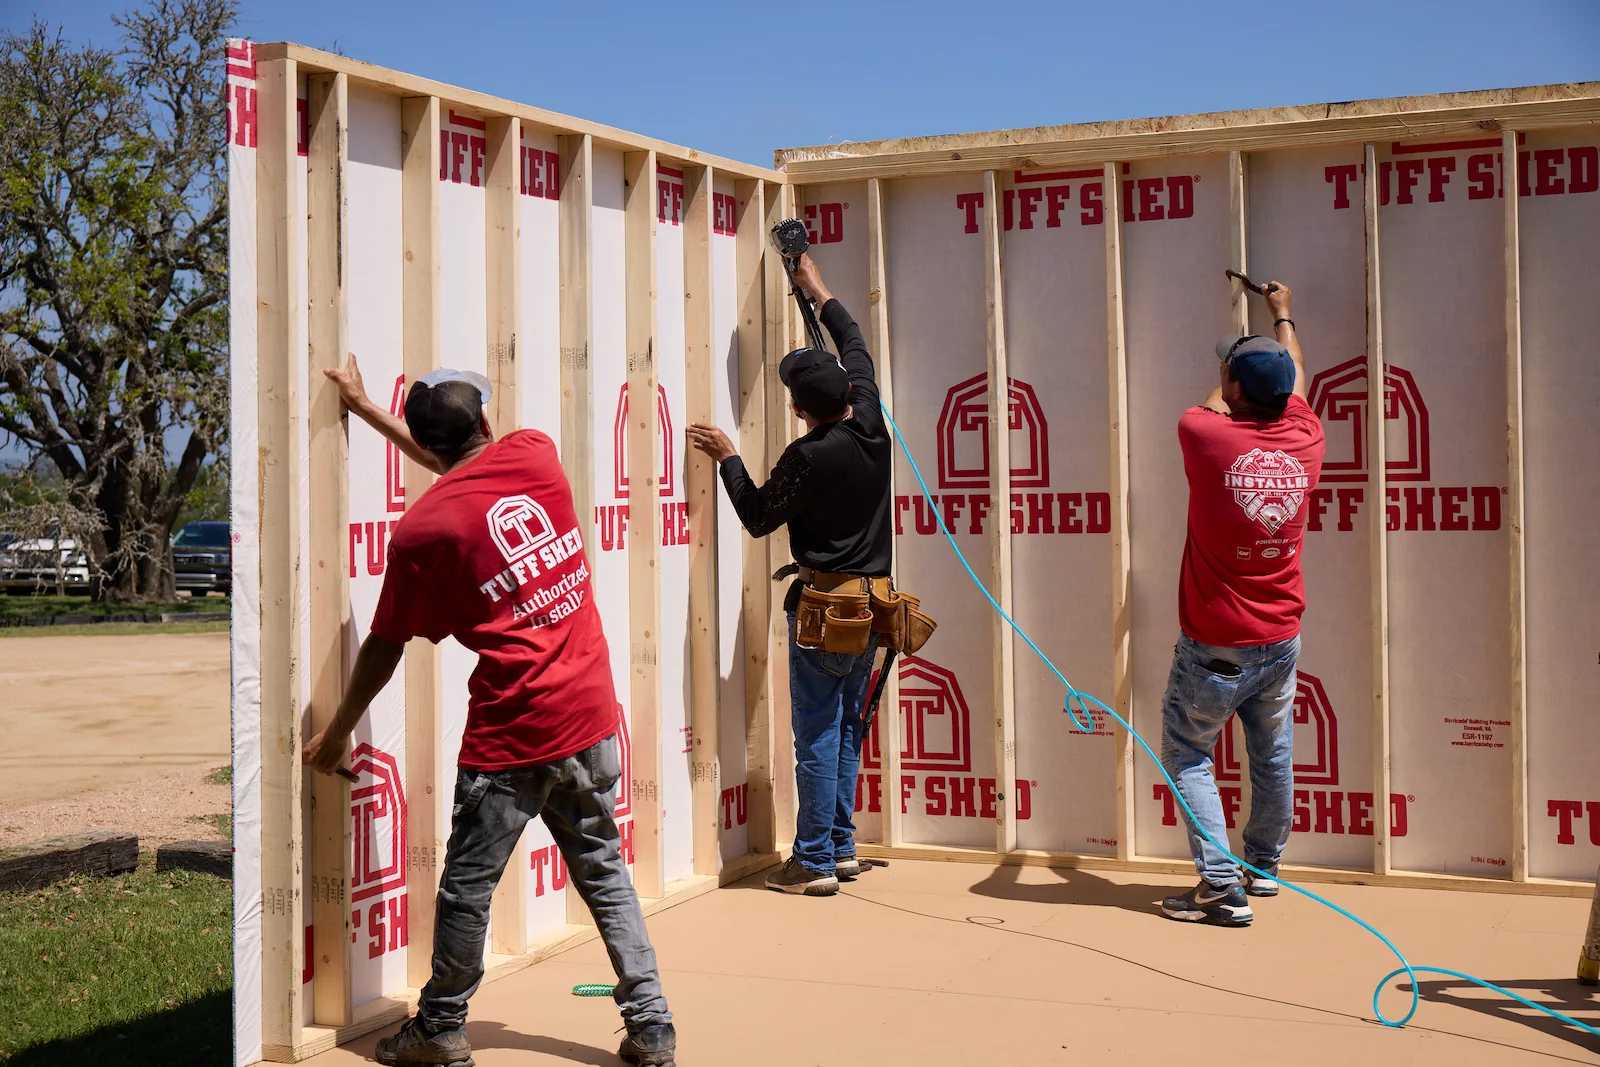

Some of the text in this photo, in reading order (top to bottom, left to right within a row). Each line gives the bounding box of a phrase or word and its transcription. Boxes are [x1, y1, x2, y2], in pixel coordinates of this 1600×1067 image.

[480, 527, 583, 603] TUFF SHED
[512, 559, 589, 621] Authorized
